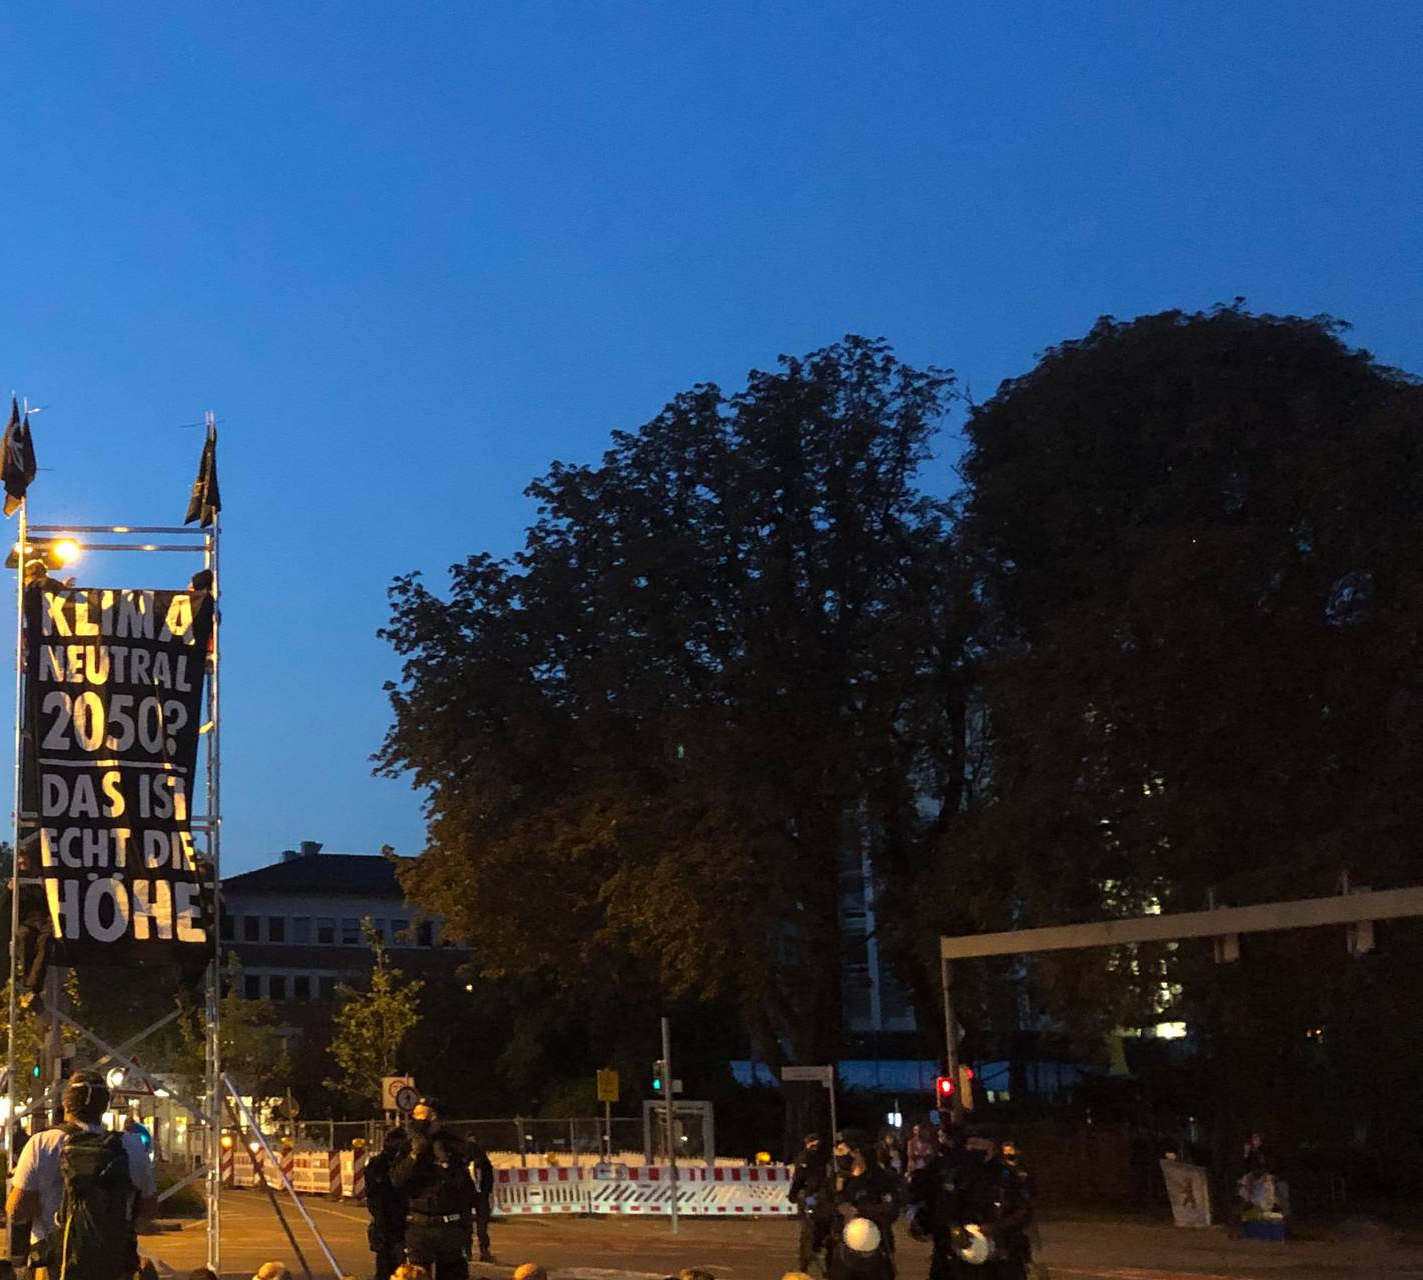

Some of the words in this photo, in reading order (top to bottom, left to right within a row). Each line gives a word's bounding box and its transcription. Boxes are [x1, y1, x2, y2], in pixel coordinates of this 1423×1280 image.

[41, 590, 195, 645] KLIMA
[39, 645, 192, 692] NEUTRAL
[40, 690, 188, 756] 2050?
[42, 771, 126, 820] DAS
[138, 773, 187, 821] IST
[40, 827, 131, 868] ECHT
[143, 829, 197, 872] DIE
[44, 872, 207, 943] HÖHE
